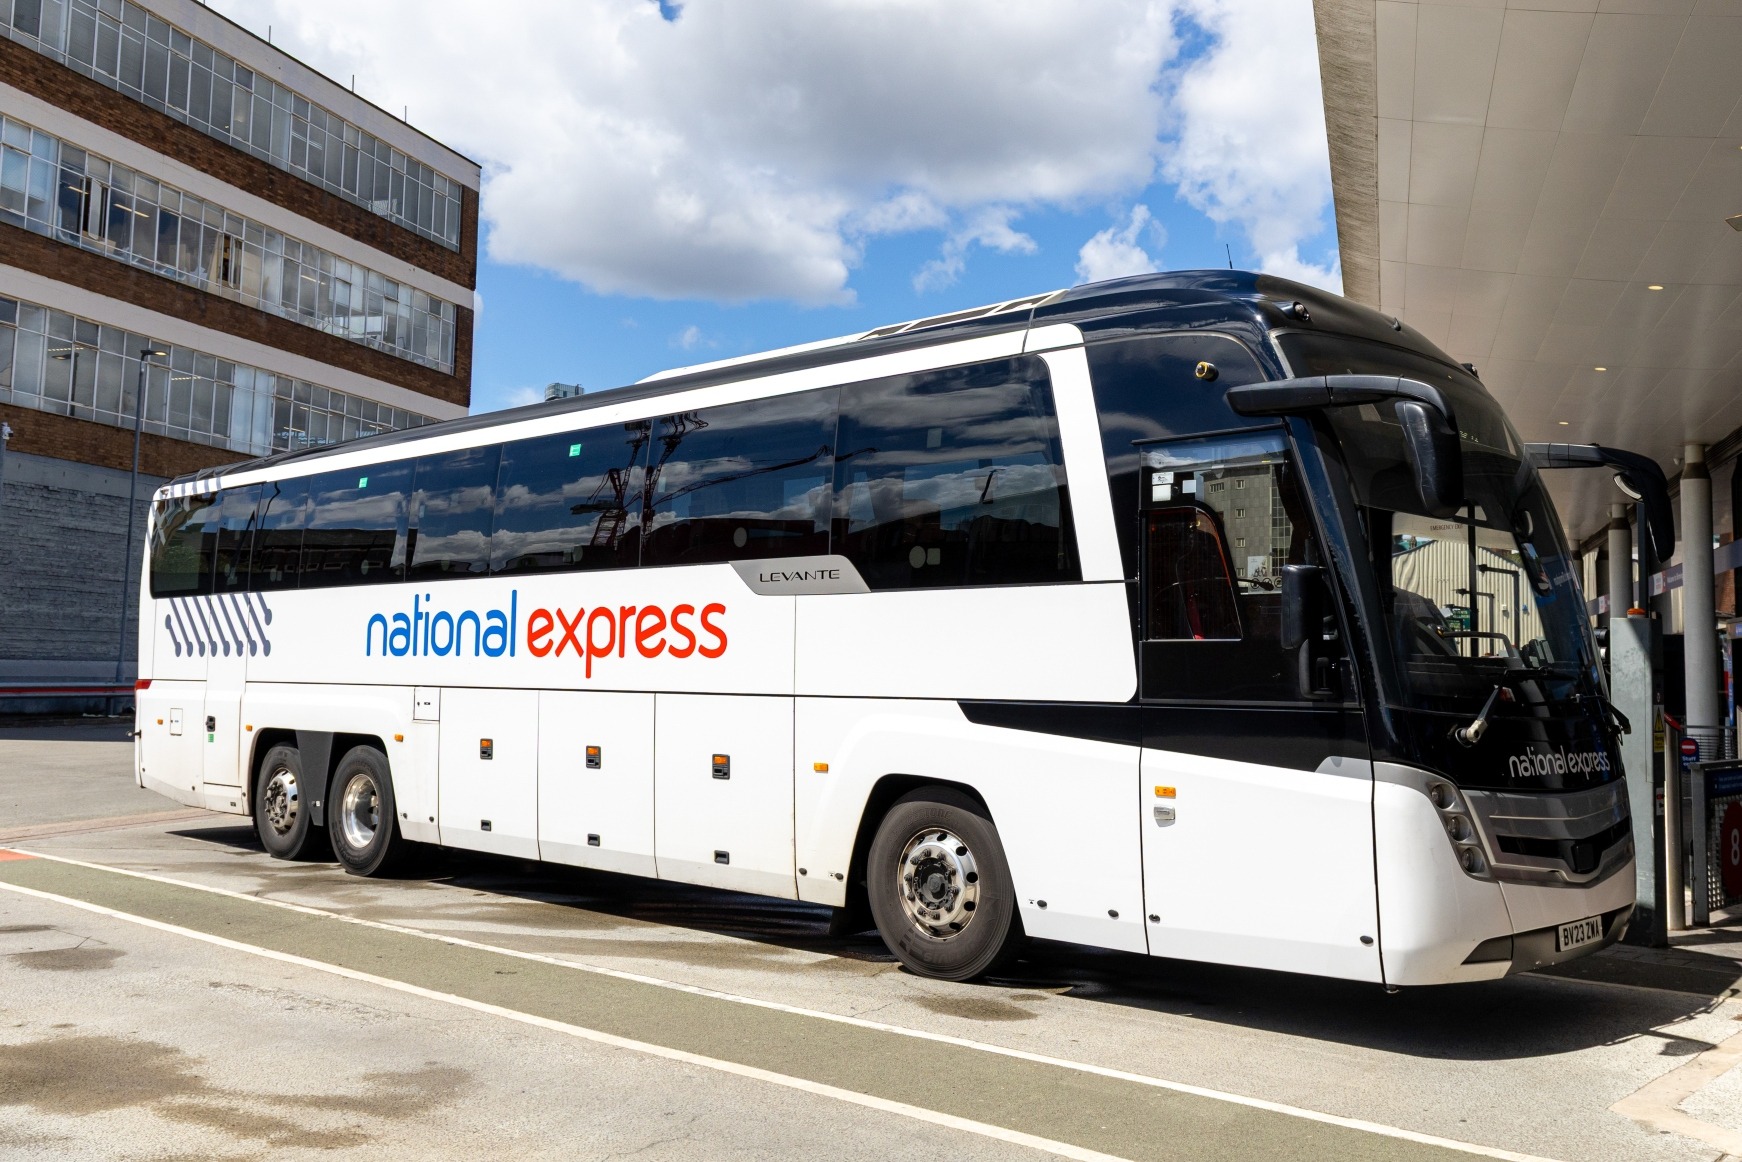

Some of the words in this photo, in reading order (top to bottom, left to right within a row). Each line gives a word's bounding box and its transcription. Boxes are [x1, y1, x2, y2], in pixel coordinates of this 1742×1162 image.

[759, 569, 840, 583] LEVANTE
[366, 589, 517, 658] national
[526, 602, 728, 679] express
[1509, 745, 1568, 778] national
[1568, 751, 1611, 780] express
[1730, 828, 1740, 867] 8
[1562, 924, 1585, 946] BV23
[1585, 919, 1600, 940] ZWA
